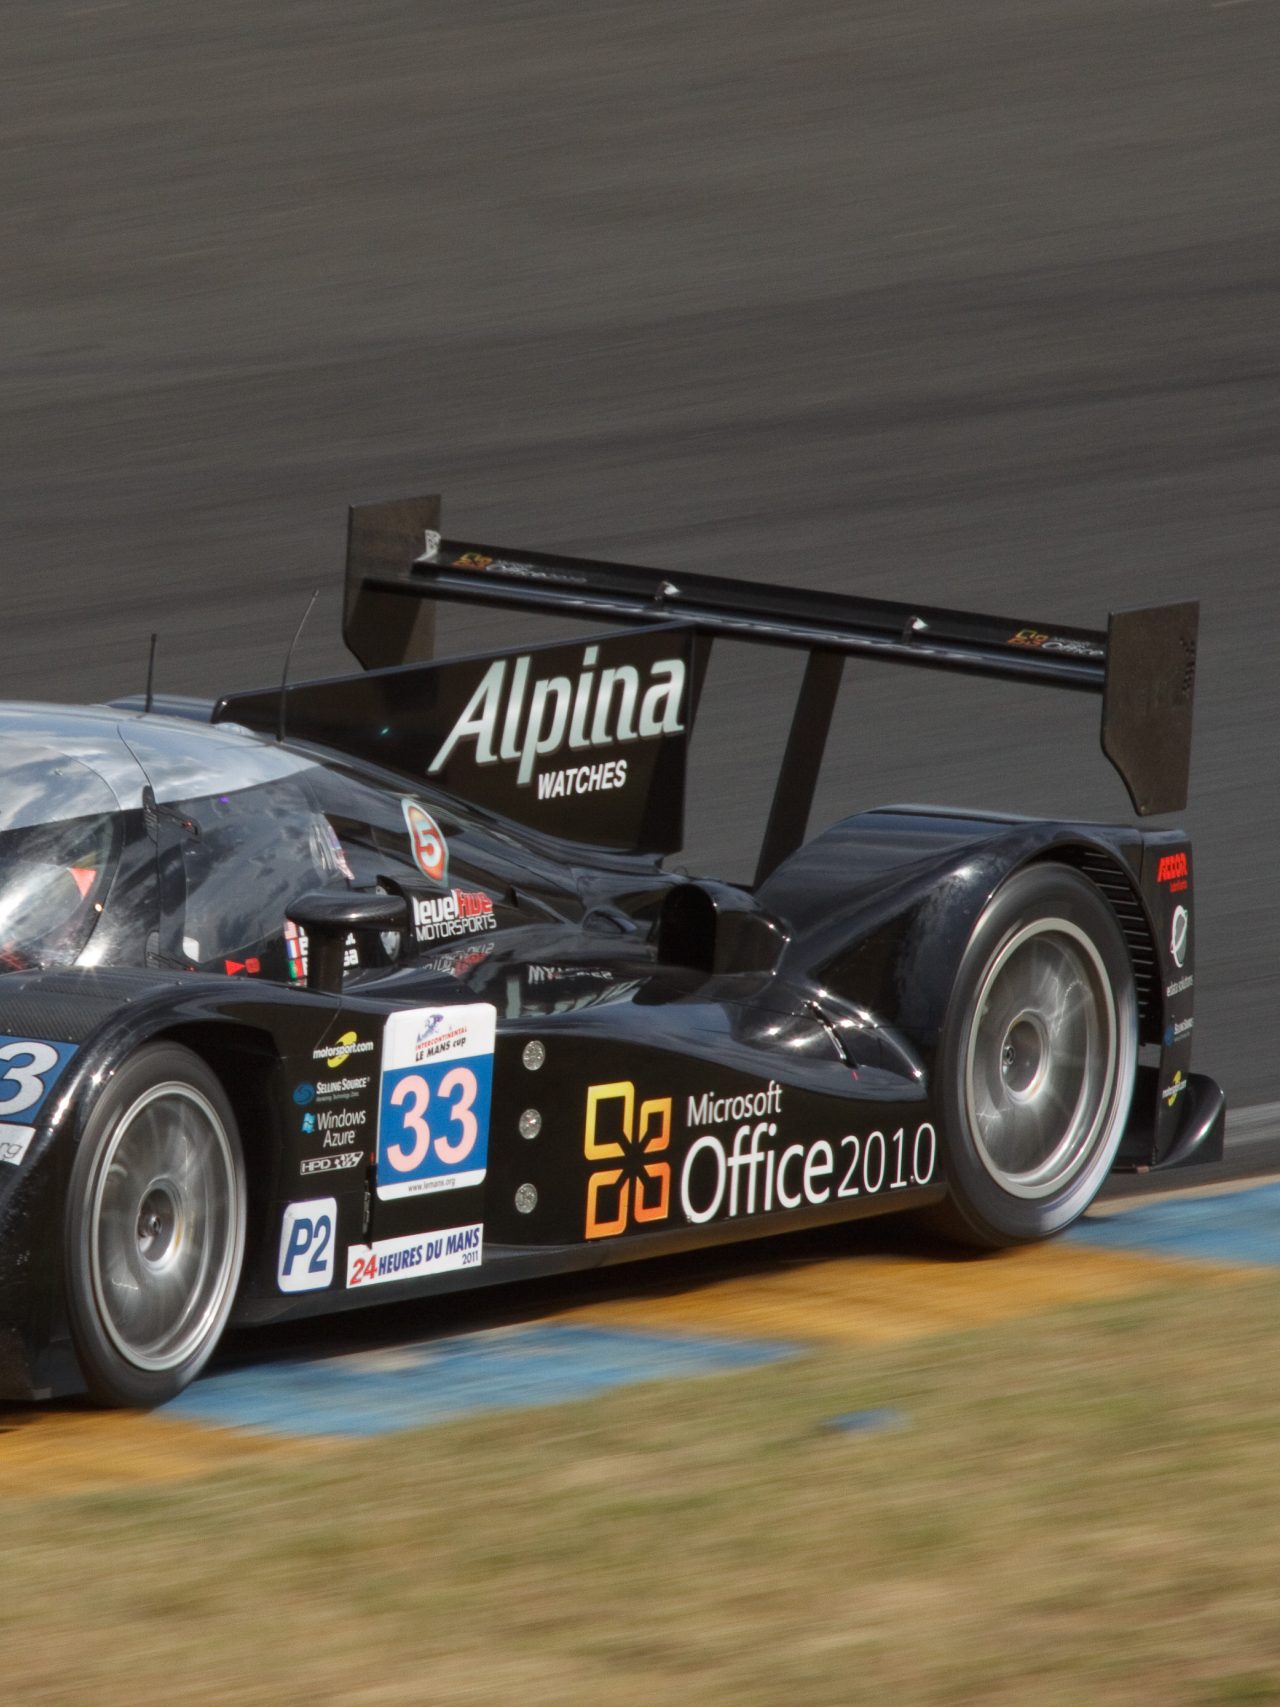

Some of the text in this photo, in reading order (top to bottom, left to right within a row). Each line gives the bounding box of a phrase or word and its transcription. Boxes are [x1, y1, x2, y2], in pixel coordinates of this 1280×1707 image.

[427, 645, 686, 785] Alpina
[538, 759, 628, 800] WATCHES
[415, 820, 442, 868] 5
[415, 912, 498, 942] MOTORSPORTS
[313, 1041, 374, 1059] motorsport.com
[415, 1050, 424, 1062] LE
[427, 1041, 451, 1057] MANS
[416, 1025, 468, 1051] INTERCONTINENTAL
[317, 1107, 366, 1131] Windows
[387, 1067, 479, 1173] 33
[687, 1080, 782, 1127] Microsoft
[322, 1129, 356, 1149] Azure
[301, 1158, 332, 1173] HPD
[681, 1122, 937, 1224] Office 2010
[282, 1214, 332, 1276] P2
[378, 1245, 423, 1277] HEURES
[425, 1238, 444, 1262] DU
[445, 1227, 480, 1256] MANS
[462, 1250, 479, 1265] 2011
